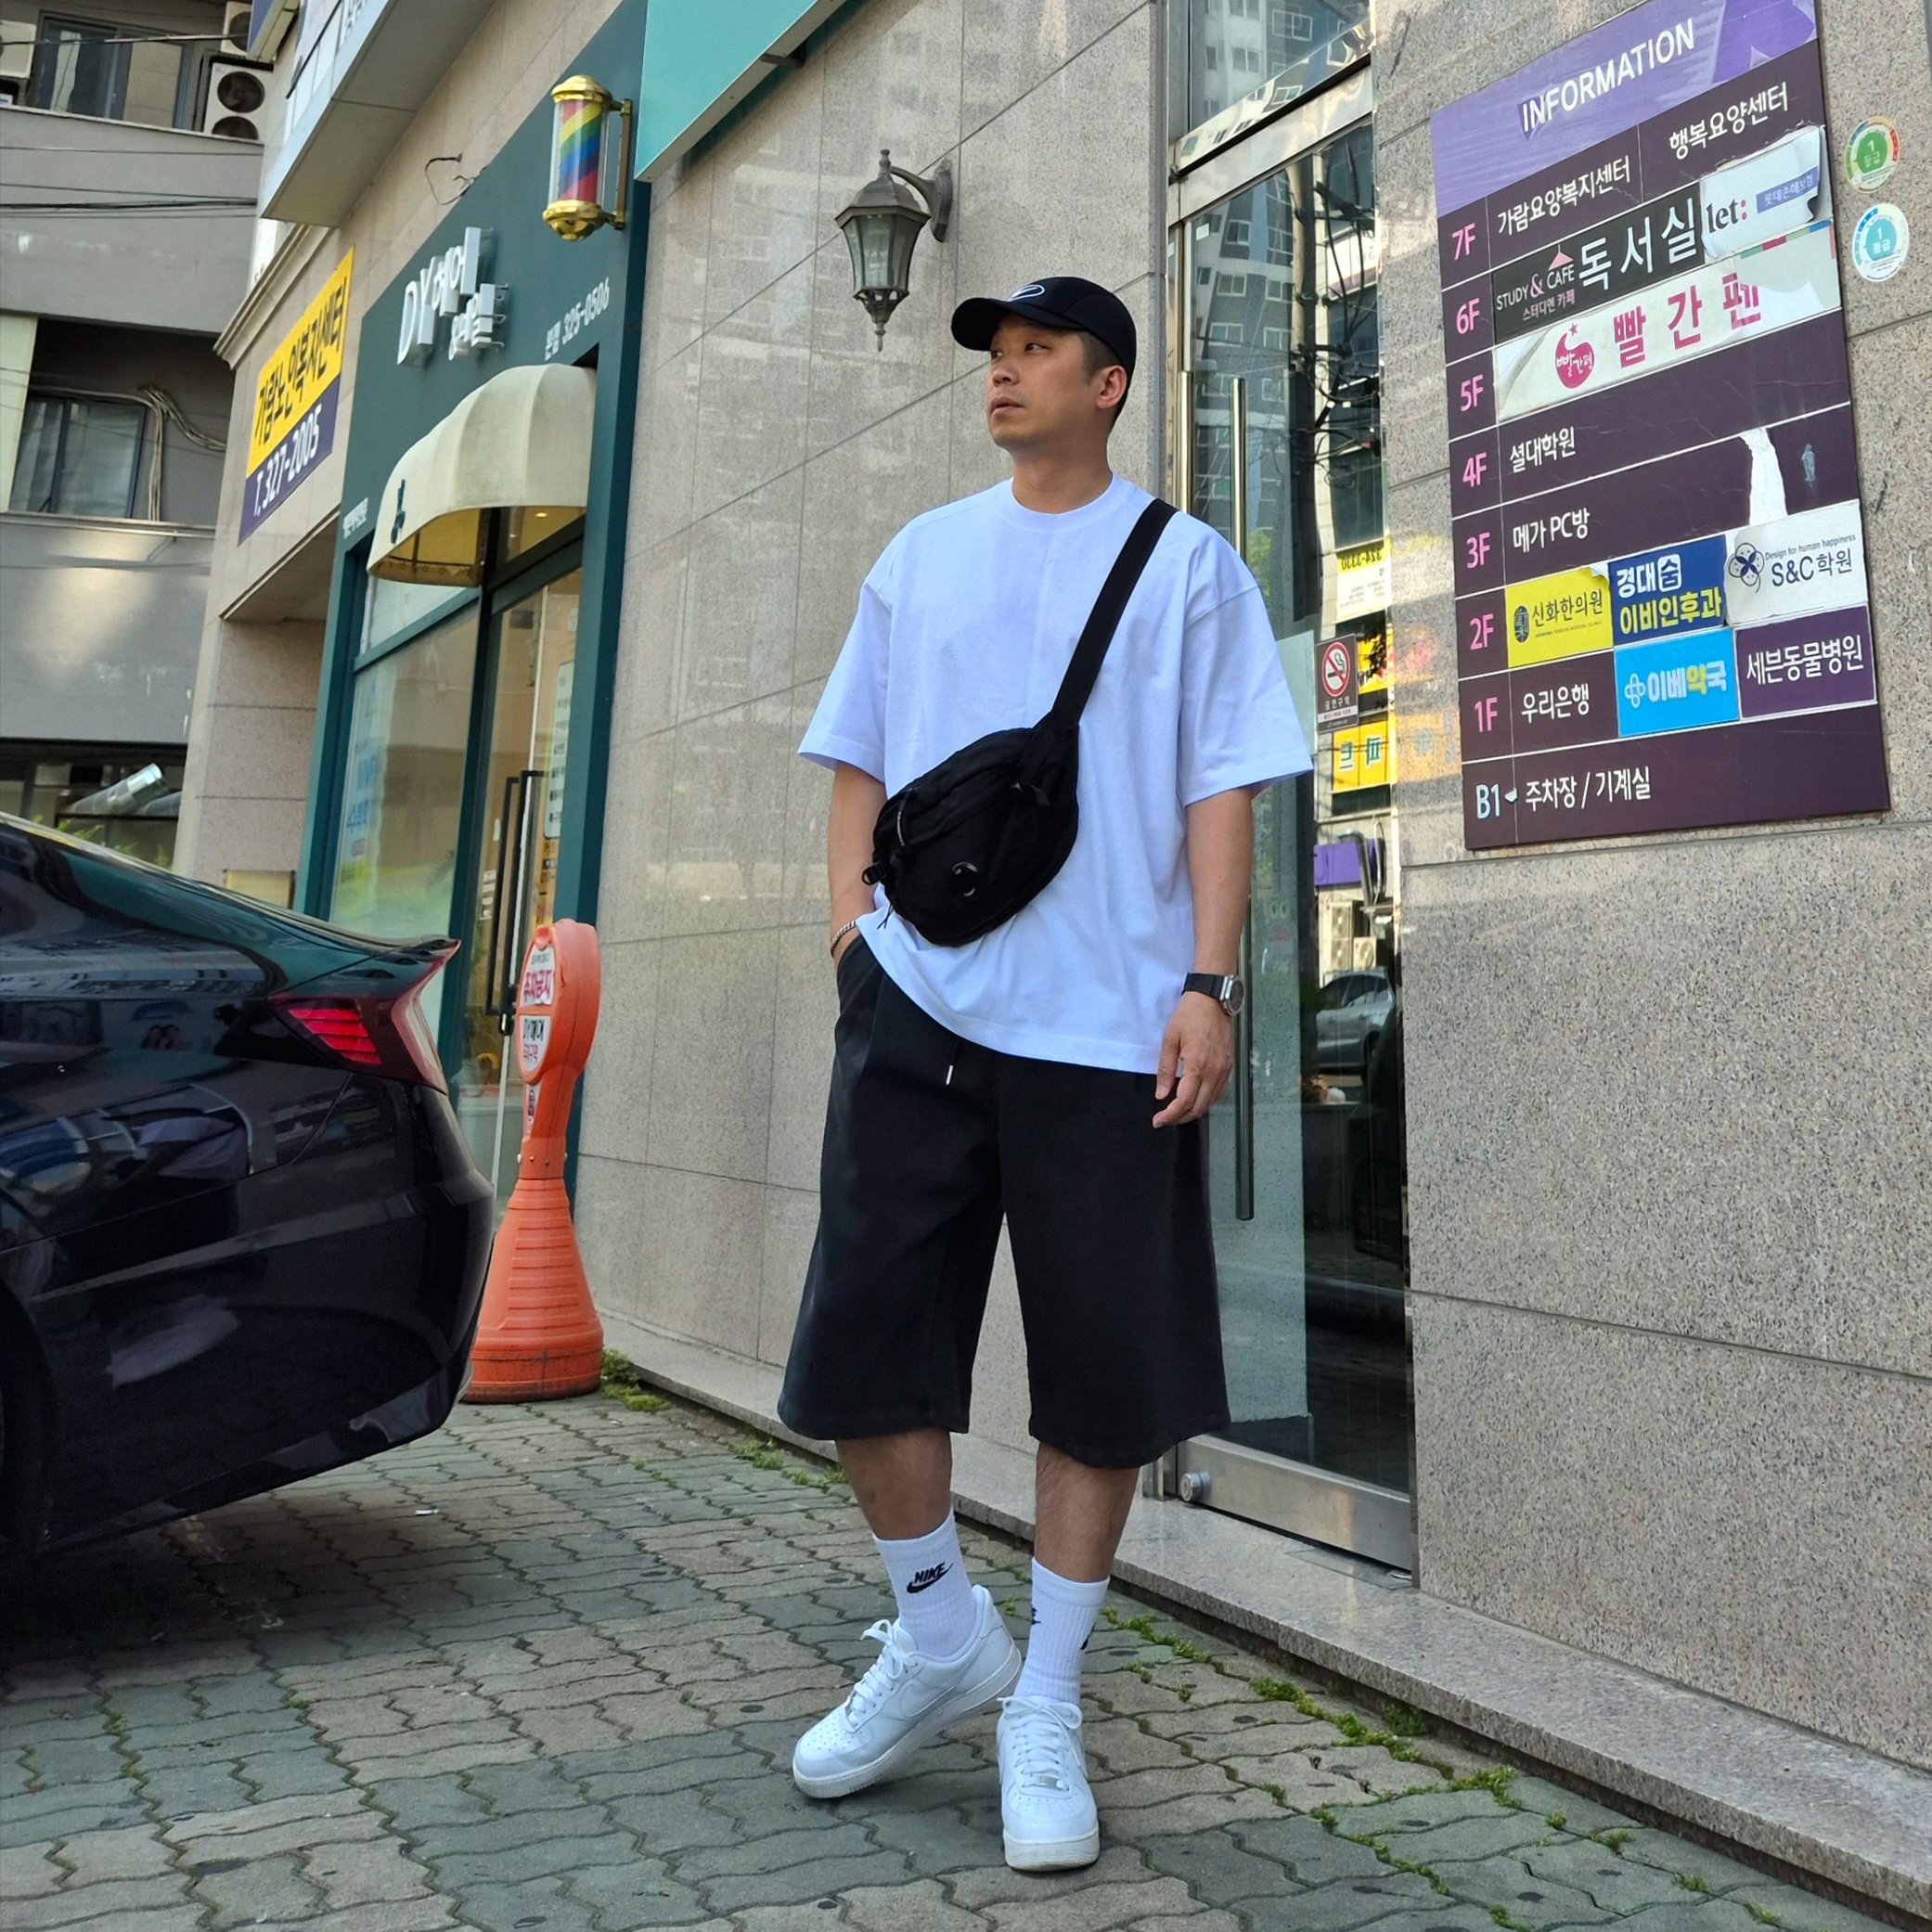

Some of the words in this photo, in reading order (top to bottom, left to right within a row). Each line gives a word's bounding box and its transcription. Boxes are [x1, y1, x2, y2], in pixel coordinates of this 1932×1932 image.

[1521, 18, 1696, 132] INFORMATION
[1669, 83, 1789, 161] 행복요양센터
[1497, 155, 1631, 237] 가람요양복지센터
[1764, 173, 1814, 206] 롯데손해보험
[1452, 224, 1477, 261] 7F
[1873, 238, 1891, 255] 등급
[1876, 226, 1883, 240] 1
[1496, 284, 1528, 311] STUDY
[1530, 274, 1545, 298] &
[1547, 264, 1575, 290] CAFE
[1523, 297, 1556, 322] 스터디엔
[1557, 289, 1576, 309] 카페
[562, 277, 612, 345] 325-0506
[1455, 299, 1481, 335] 6F
[254, 277, 347, 446] 가람노인복지센터
[1460, 375, 1484, 411] 5F
[1462, 452, 1488, 488] 4F
[1466, 532, 1491, 569] 3F
[1513, 522, 1547, 554] 메가
[1550, 509, 1591, 542] PC방
[1765, 549, 1788, 560] Design
[1788, 546, 1797, 555] for
[1798, 541, 1821, 552] human
[1822, 534, 1857, 547] happiness
[1771, 555, 1814, 587] S&C
[1816, 547, 1853, 576] 학원
[1532, 588, 1603, 627] 신화한의원
[1619, 586, 1722, 635] 이비인후과
[1470, 613, 1495, 650] 2F
[1746, 635, 1864, 685] 세븐동물병원
[1647, 660, 1727, 702] 이베약국
[1474, 698, 1498, 733] 1F
[1521, 683, 1591, 725] 우리은행
[1475, 784, 1501, 819] B1
[1525, 777, 1578, 812] 주차장
[1595, 767, 1651, 802] 기계실
[914, 1562, 947, 1585] NIKE
